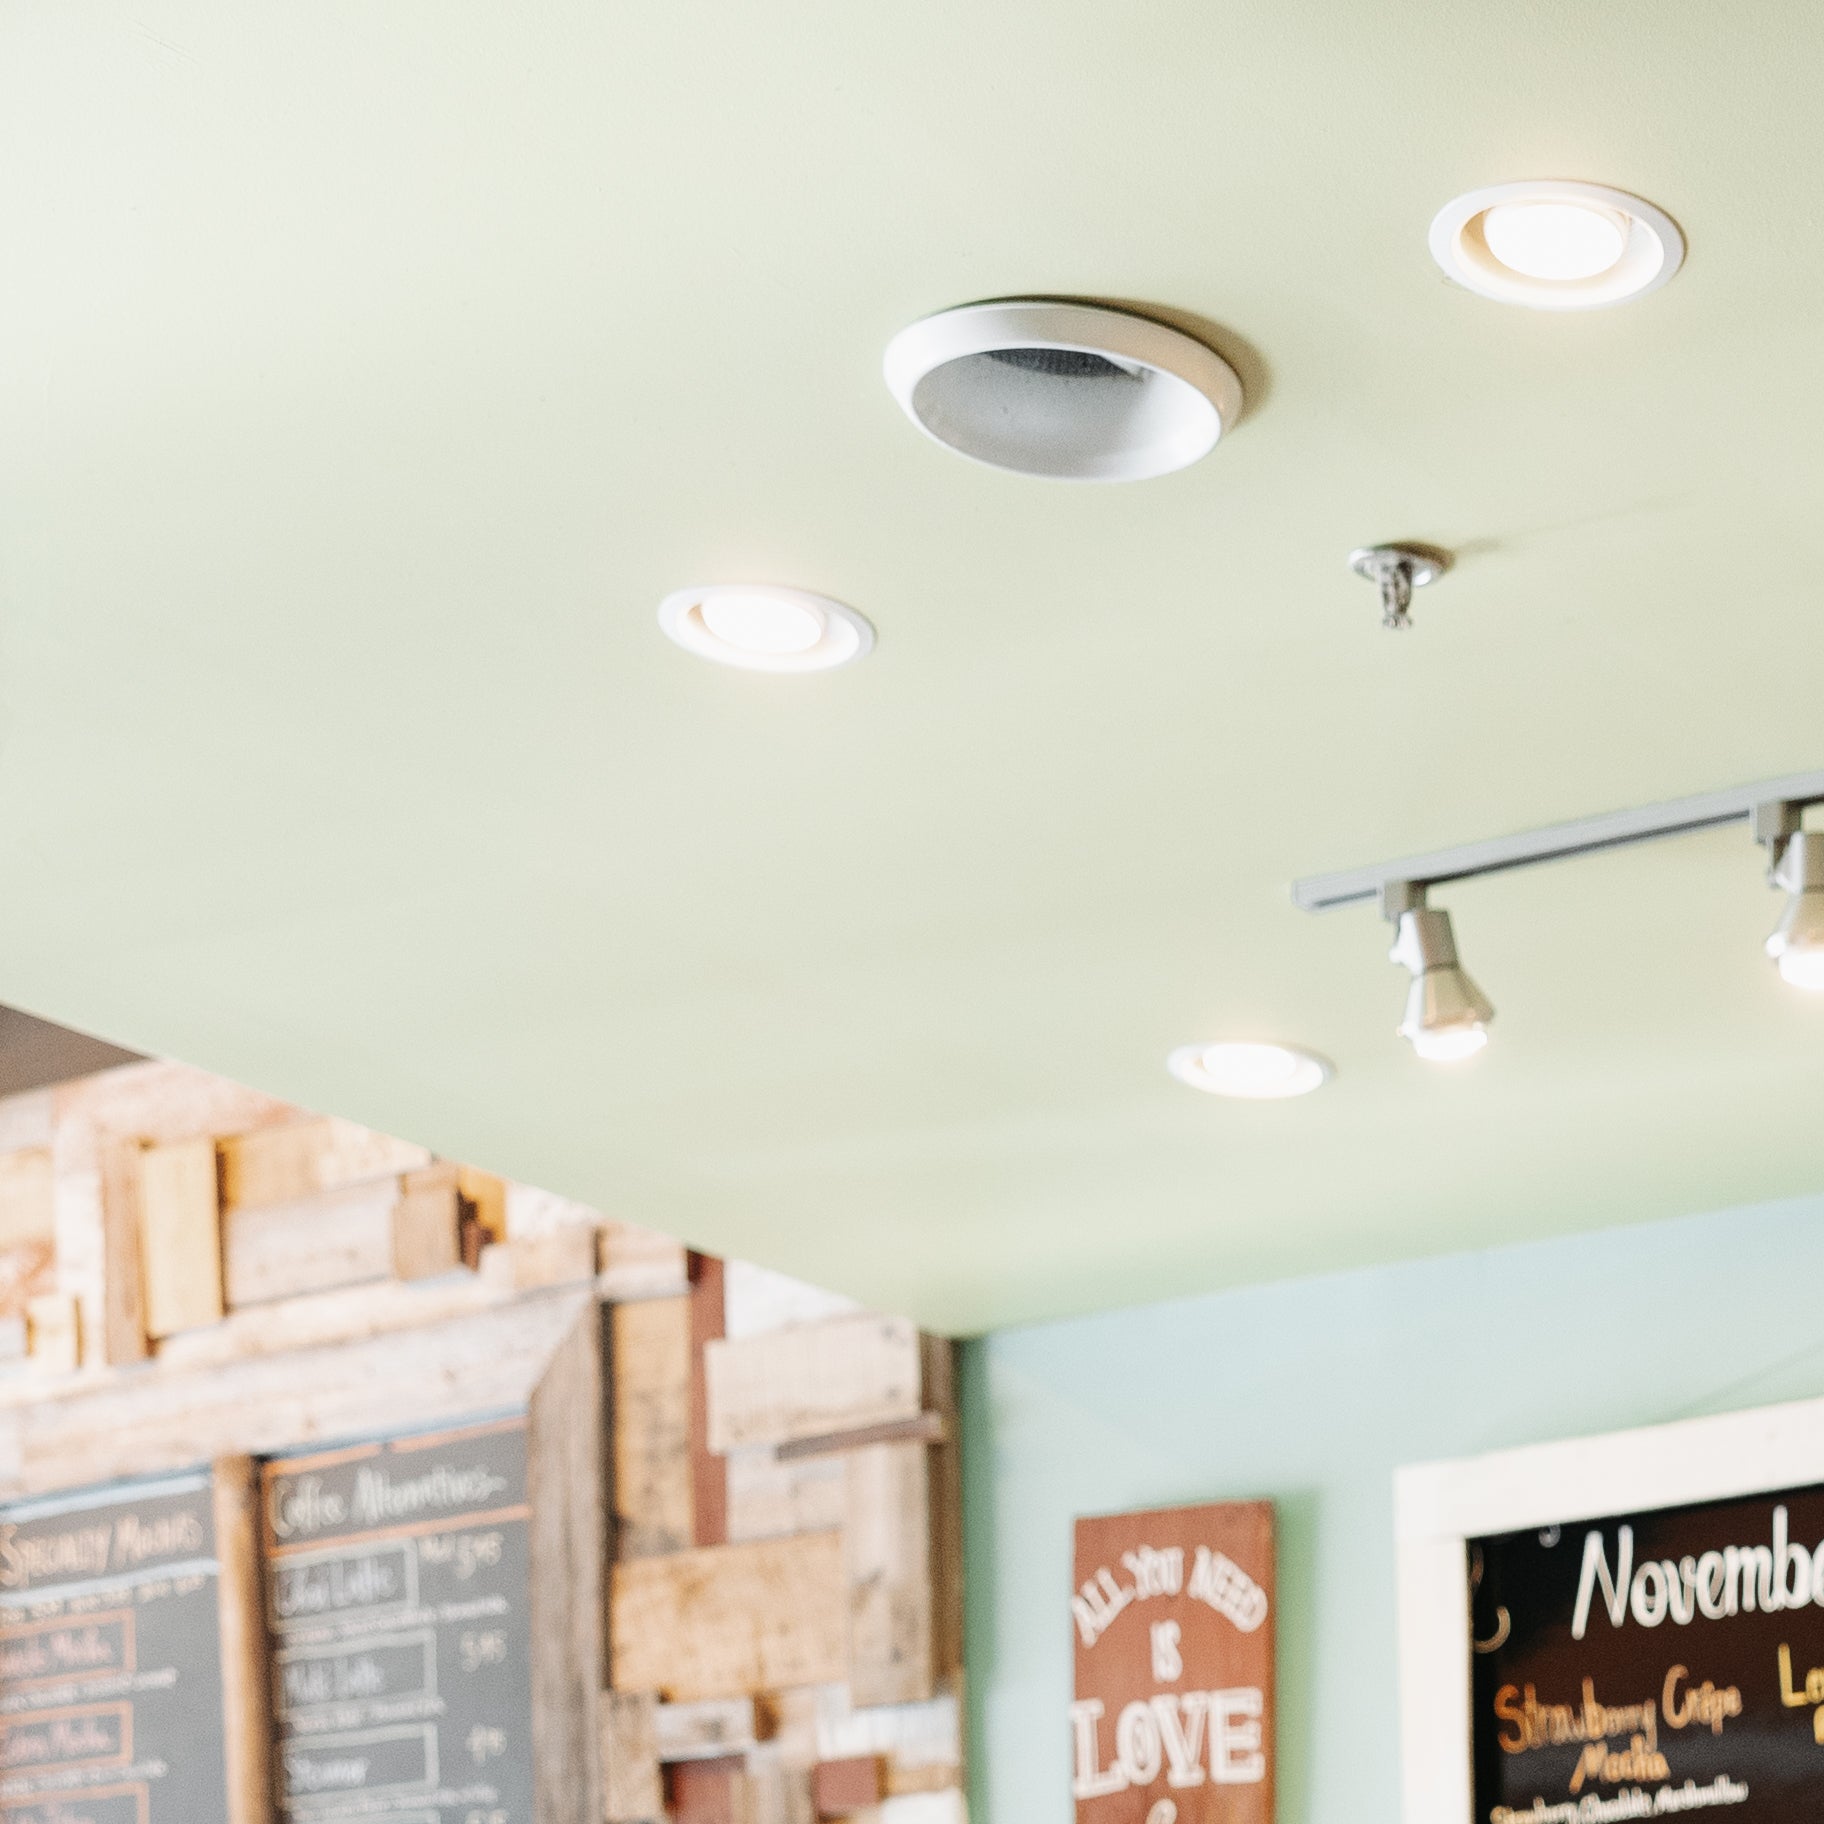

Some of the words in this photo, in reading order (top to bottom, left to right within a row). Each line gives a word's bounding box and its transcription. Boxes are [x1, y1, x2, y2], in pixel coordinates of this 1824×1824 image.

[1071, 1566, 1137, 1649] ALL
[1121, 1543, 1184, 1600] YOU
[1187, 1543, 1269, 1634] NEED
[1149, 1618, 1183, 1683] IS
[1071, 1686, 1265, 1800] LOVE
[1494, 1676, 1658, 1754] Strawberry
[1568, 1733, 1671, 1794] Mocha
